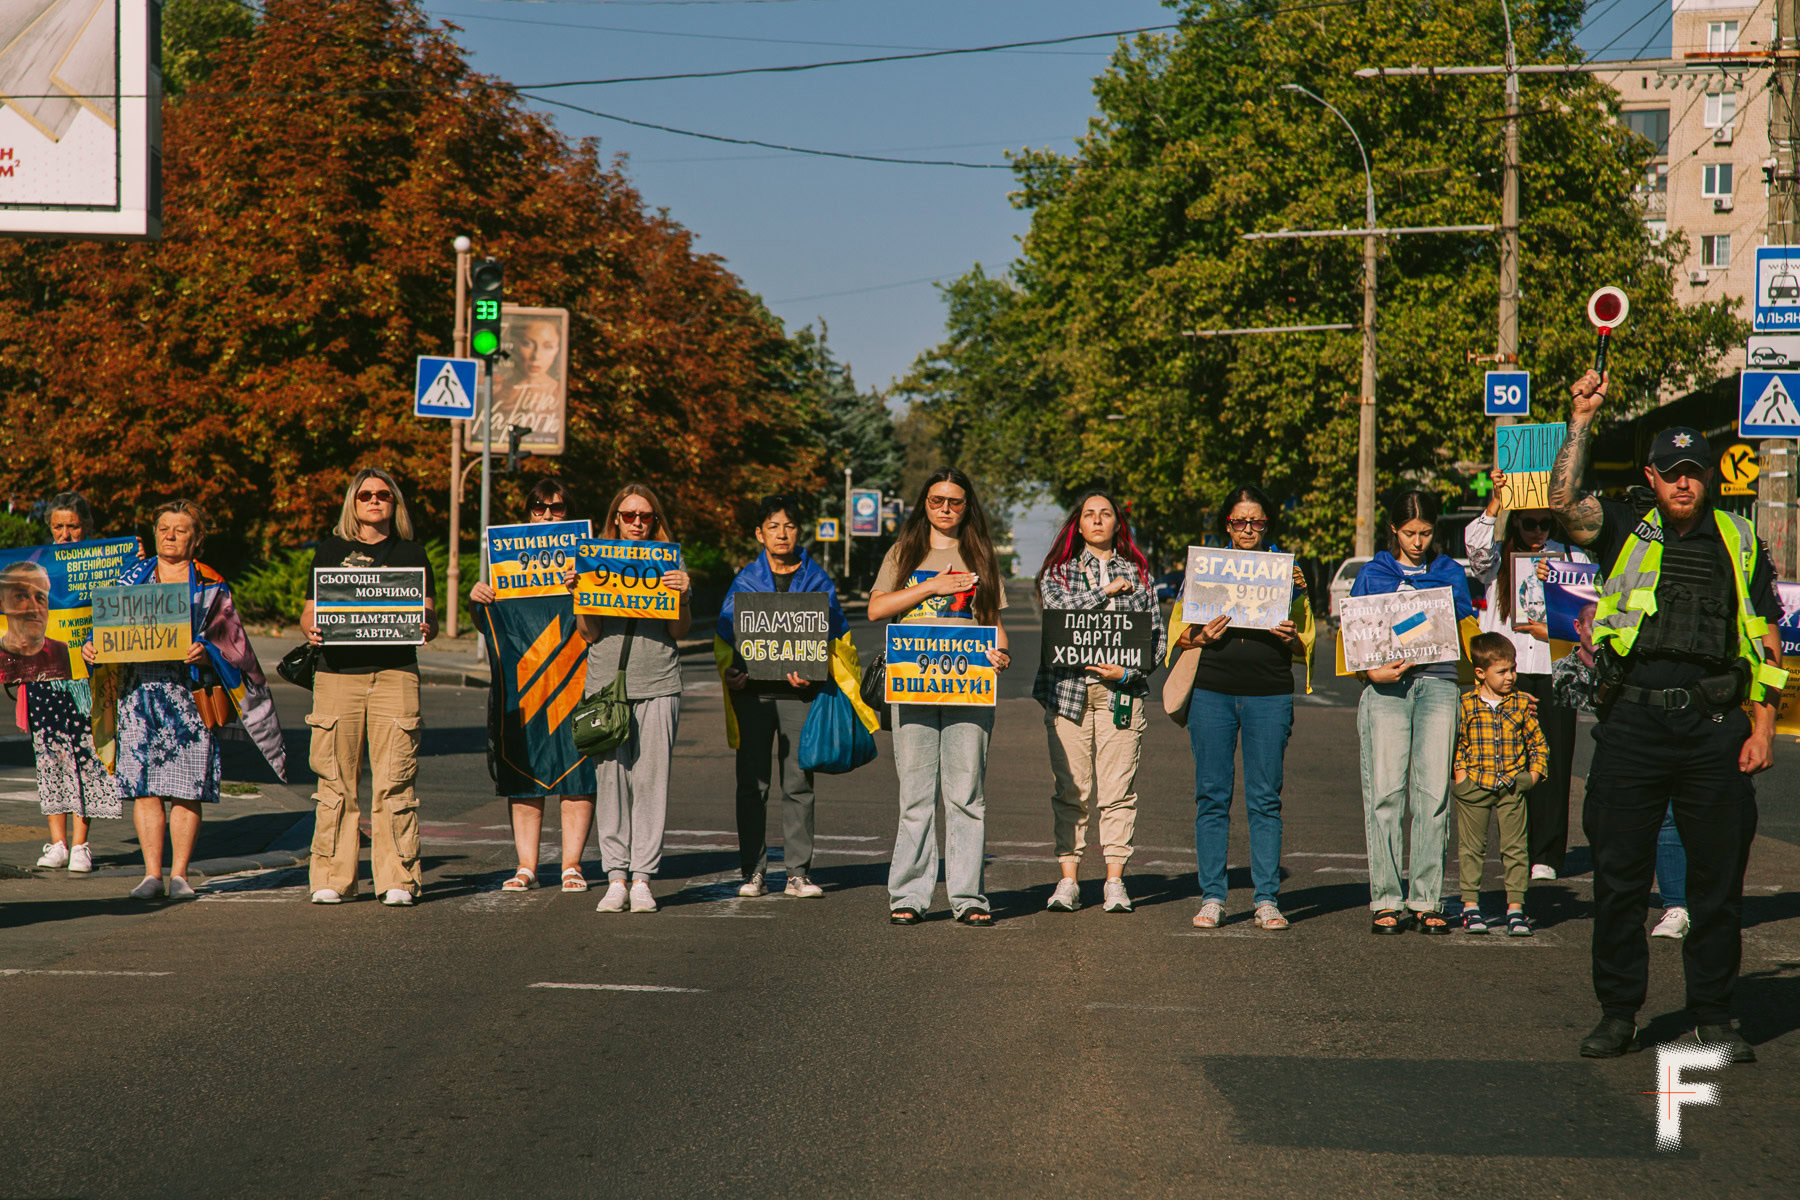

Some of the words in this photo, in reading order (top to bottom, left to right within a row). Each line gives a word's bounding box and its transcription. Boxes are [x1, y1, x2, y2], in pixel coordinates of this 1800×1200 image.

[477, 301, 498, 320] 33
[1494, 385, 1521, 405] 50
[55, 546, 103, 561] КСЬОНЖИК
[105, 542, 134, 556] ВІКТОР
[517, 548, 566, 571] 9:00
[579, 544, 677, 562] ЗУПИНИСЬ!
[67, 556, 123, 572] ЄВГЕНІЙОВИЧ
[1194, 556, 1288, 581] ЗГАДАЙ
[68, 570, 107, 582] 21.07.1981
[319, 574, 381, 585] СЬОГОДНІ
[594, 563, 660, 590] 9:00
[68, 582, 87, 592] ЗНИК
[355, 587, 422, 598] МОВЧИМО,
[1236, 583, 1280, 601] 9:00
[95, 592, 187, 619] ЗУПИНИСЬ
[578, 591, 676, 611] ВШАНУЙ!
[317, 614, 346, 626] ЩОБ
[350, 613, 421, 624] ПАМ’ЯТАЛИ
[1346, 605, 1382, 617] ТИША
[59, 619, 67, 628] ТИ
[740, 611, 829, 633] ПАМ'ЯТЬ
[1064, 612, 1133, 630] ПАМ'ЯТЬ
[72, 628, 81, 638] НЕ
[103, 624, 178, 653] ВШАНУЙ
[355, 628, 404, 638] ЗАВТРА.
[1073, 630, 1122, 646] ВАРТА
[1352, 627, 1381, 641] МИ
[741, 639, 828, 662] ОБ'ЄДНУЄ
[1052, 645, 1141, 666] ХВИЛИНИ
[1365, 652, 1383, 662] НЕ
[1388, 645, 1441, 660] ЗАБУЛИ.
[916, 653, 969, 676] 9:00
[892, 676, 992, 695] ВШАНУЙ!
